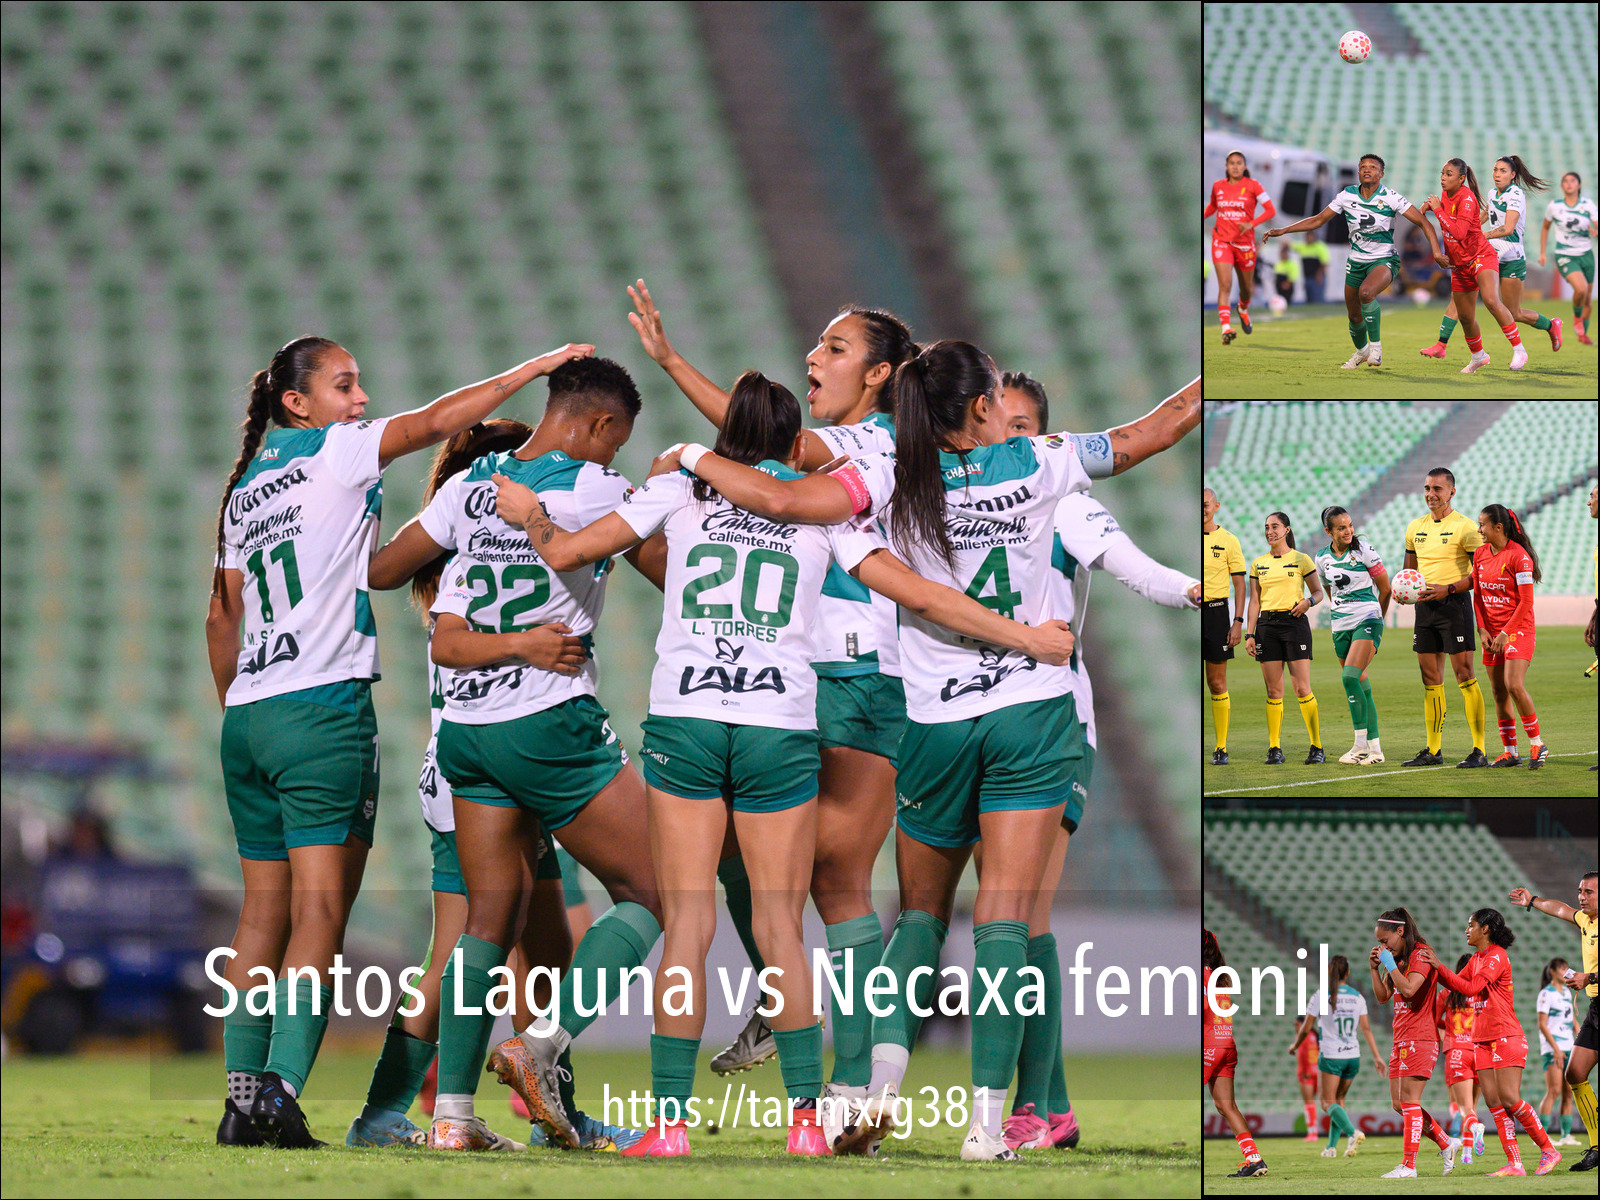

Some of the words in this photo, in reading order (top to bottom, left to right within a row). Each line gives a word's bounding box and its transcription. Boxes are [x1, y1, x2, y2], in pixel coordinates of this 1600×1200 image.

[945, 461, 983, 480] CHARLY
[838, 470, 863, 507] Educación
[701, 508, 799, 540] Caliente
[708, 530, 793, 555] caliente.mx
[246, 539, 304, 624] 11
[681, 543, 800, 628] 20
[964, 545, 1023, 620] 4
[466, 564, 551, 633] 22
[691, 620, 706, 637] L.
[711, 620, 778, 644] TORRES
[679, 665, 787, 696] LALA
[1334, 1017, 1355, 1038] 10
